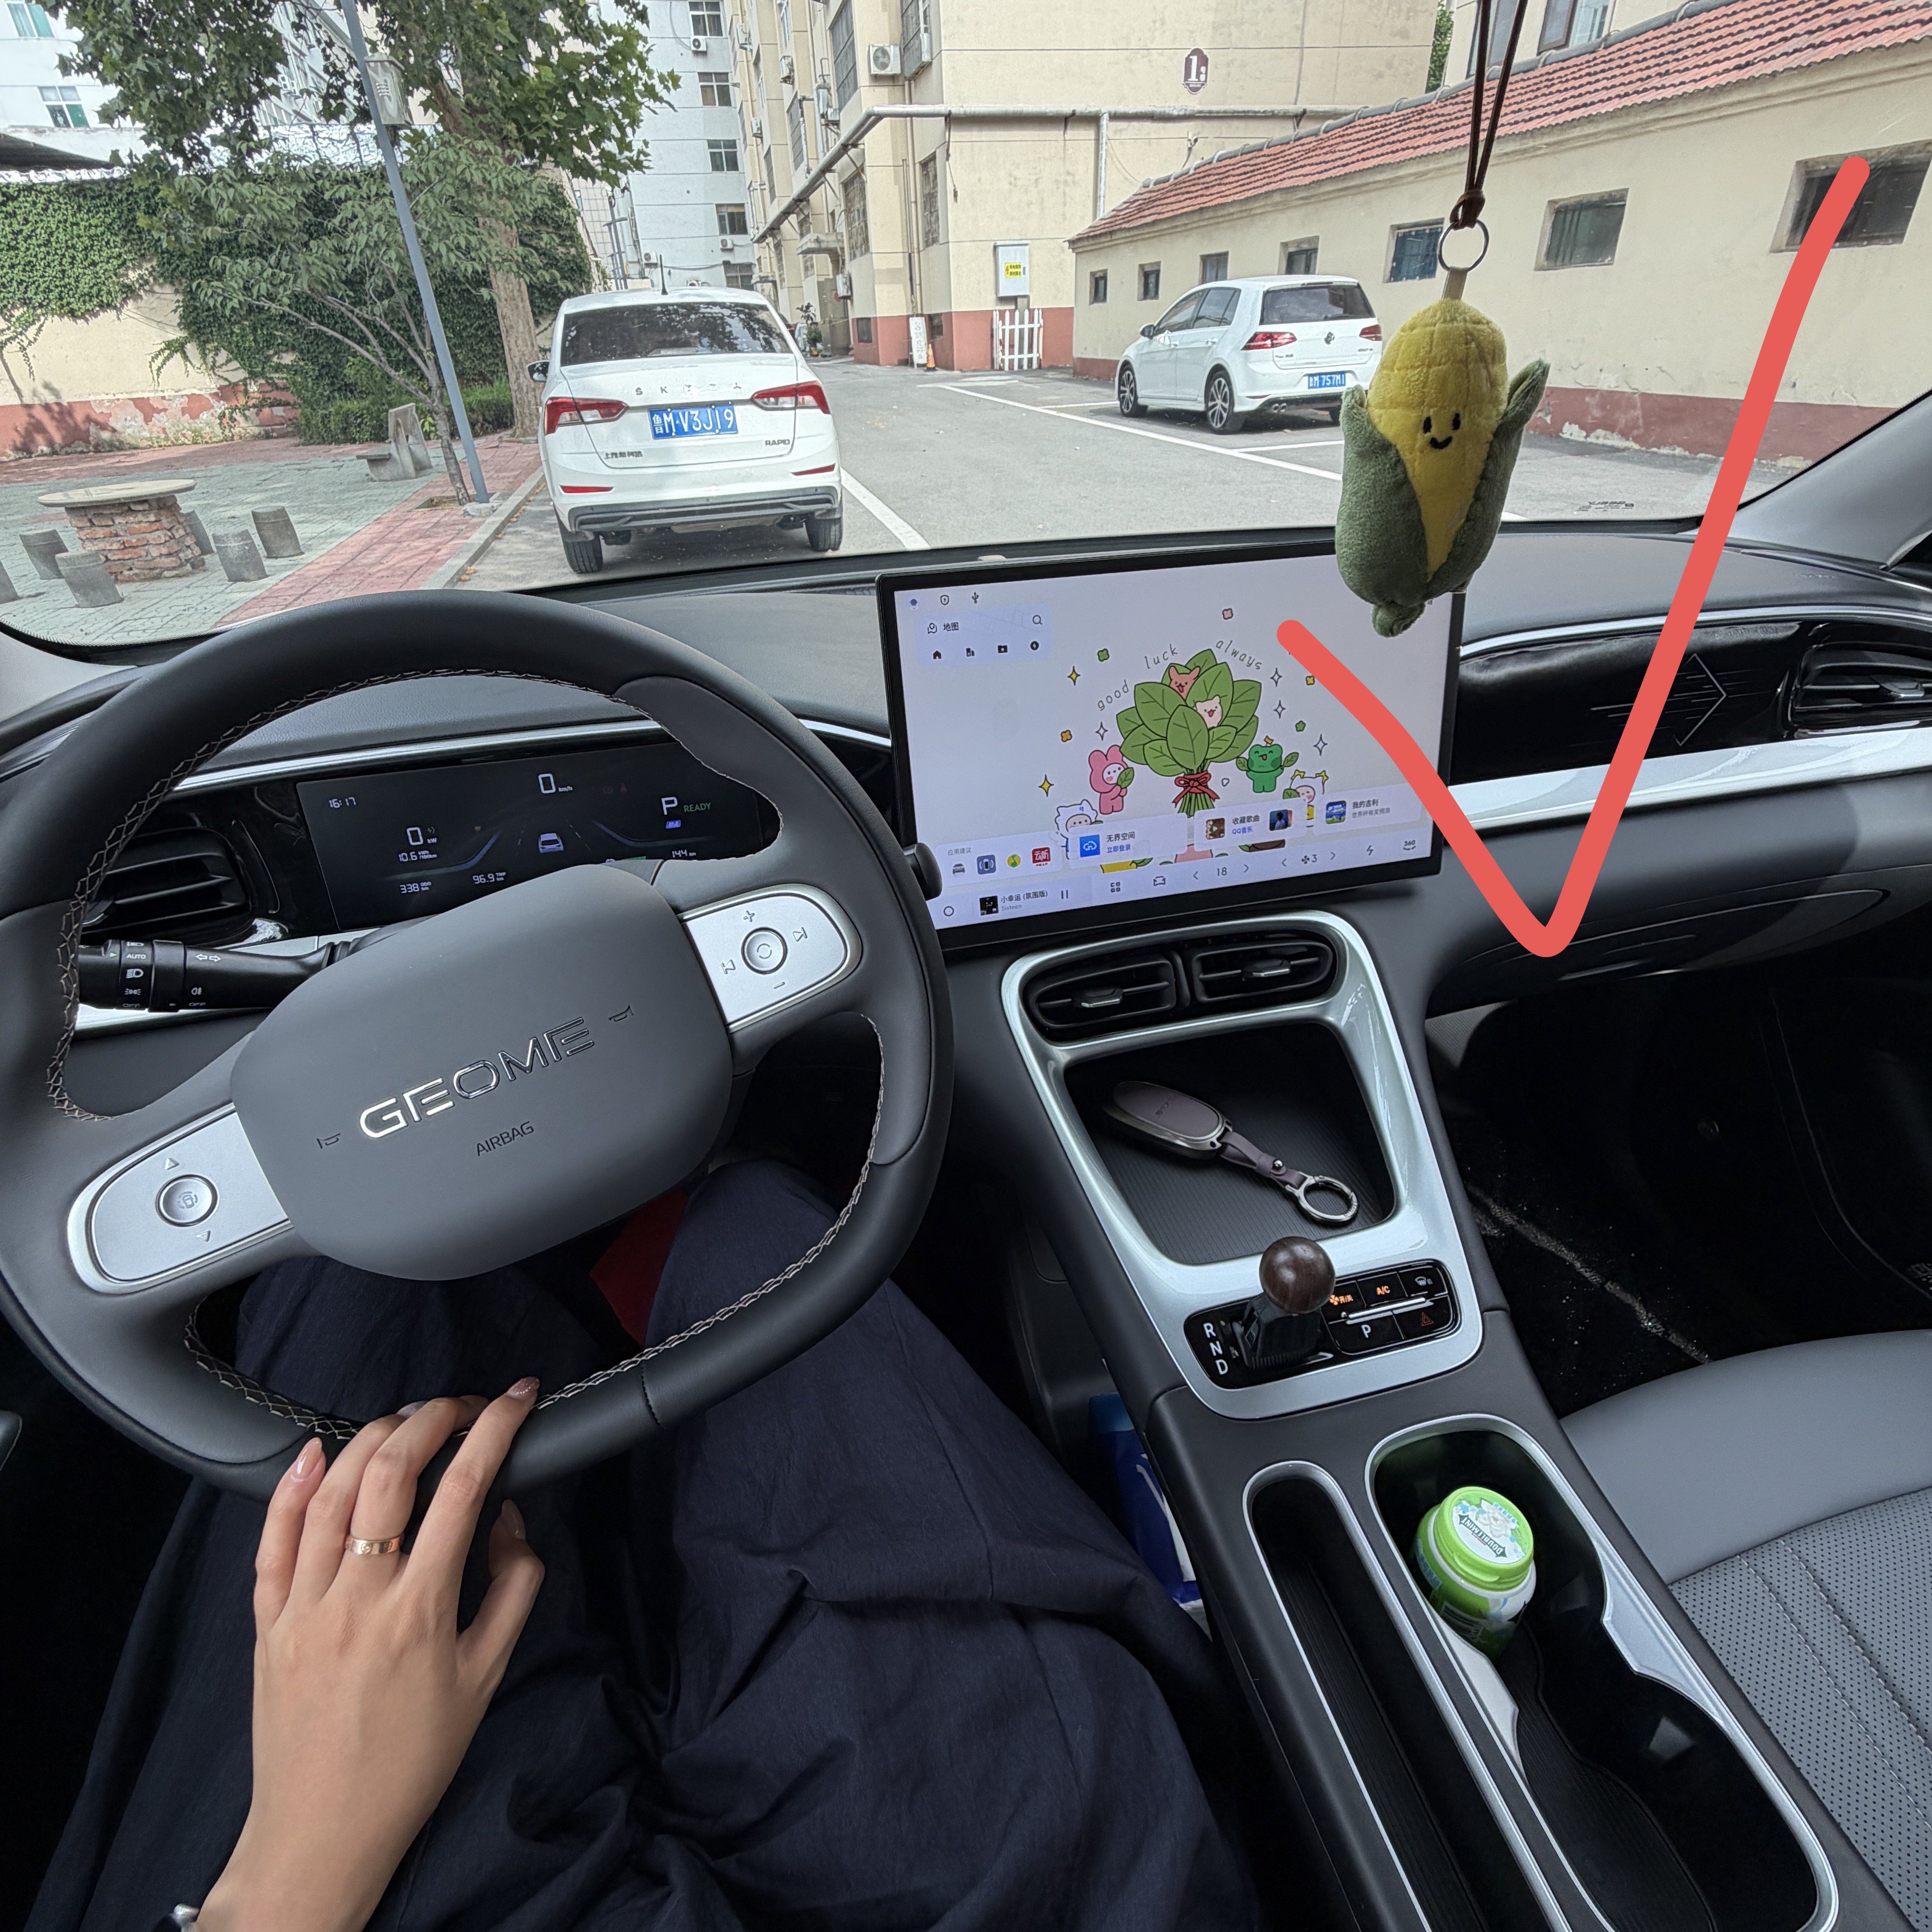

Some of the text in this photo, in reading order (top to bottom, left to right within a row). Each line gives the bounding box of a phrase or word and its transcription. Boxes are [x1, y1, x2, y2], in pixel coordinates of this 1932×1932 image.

[1187, 55, 1198, 81] 1
[635, 382, 741, 396] SKA
[765, 438, 791, 446] RAPID
[943, 622, 959, 631] 地图
[1097, 639, 1262, 711] good luck always
[538, 773, 556, 794] 0
[329, 797, 356, 808] 16:17
[661, 796, 711, 815] P READY
[1352, 799, 1379, 809] 我的吉利
[1233, 814, 1260, 825] 收藏歌曲
[1232, 826, 1253, 834] QQ音乐
[406, 827, 423, 846] 0
[1106, 831, 1135, 842] 无界空间
[672, 849, 687, 858] 144
[948, 847, 971, 856] 应用建议
[1107, 844, 1131, 853] 立即登录
[399, 851, 417, 862] 10.6
[1311, 854, 1317, 863] 3
[1217, 867, 1227, 876] 18
[473, 873, 495, 884] 96.9
[400, 883, 419, 893] 338
[1001, 894, 1021, 903] 小幸运
[359, 1016, 595, 1139] GEOME
[477, 1121, 534, 1157] AIRBAG
[1376, 1285, 1390, 1295] A/C
[1203, 1322, 1216, 1339] R
[1361, 1325, 1371, 1339] P
[1210, 1341, 1223, 1357] N
[1215, 1359, 1228, 1375] D
[1460, 1517, 1504, 1555] DOUBLEMINT
